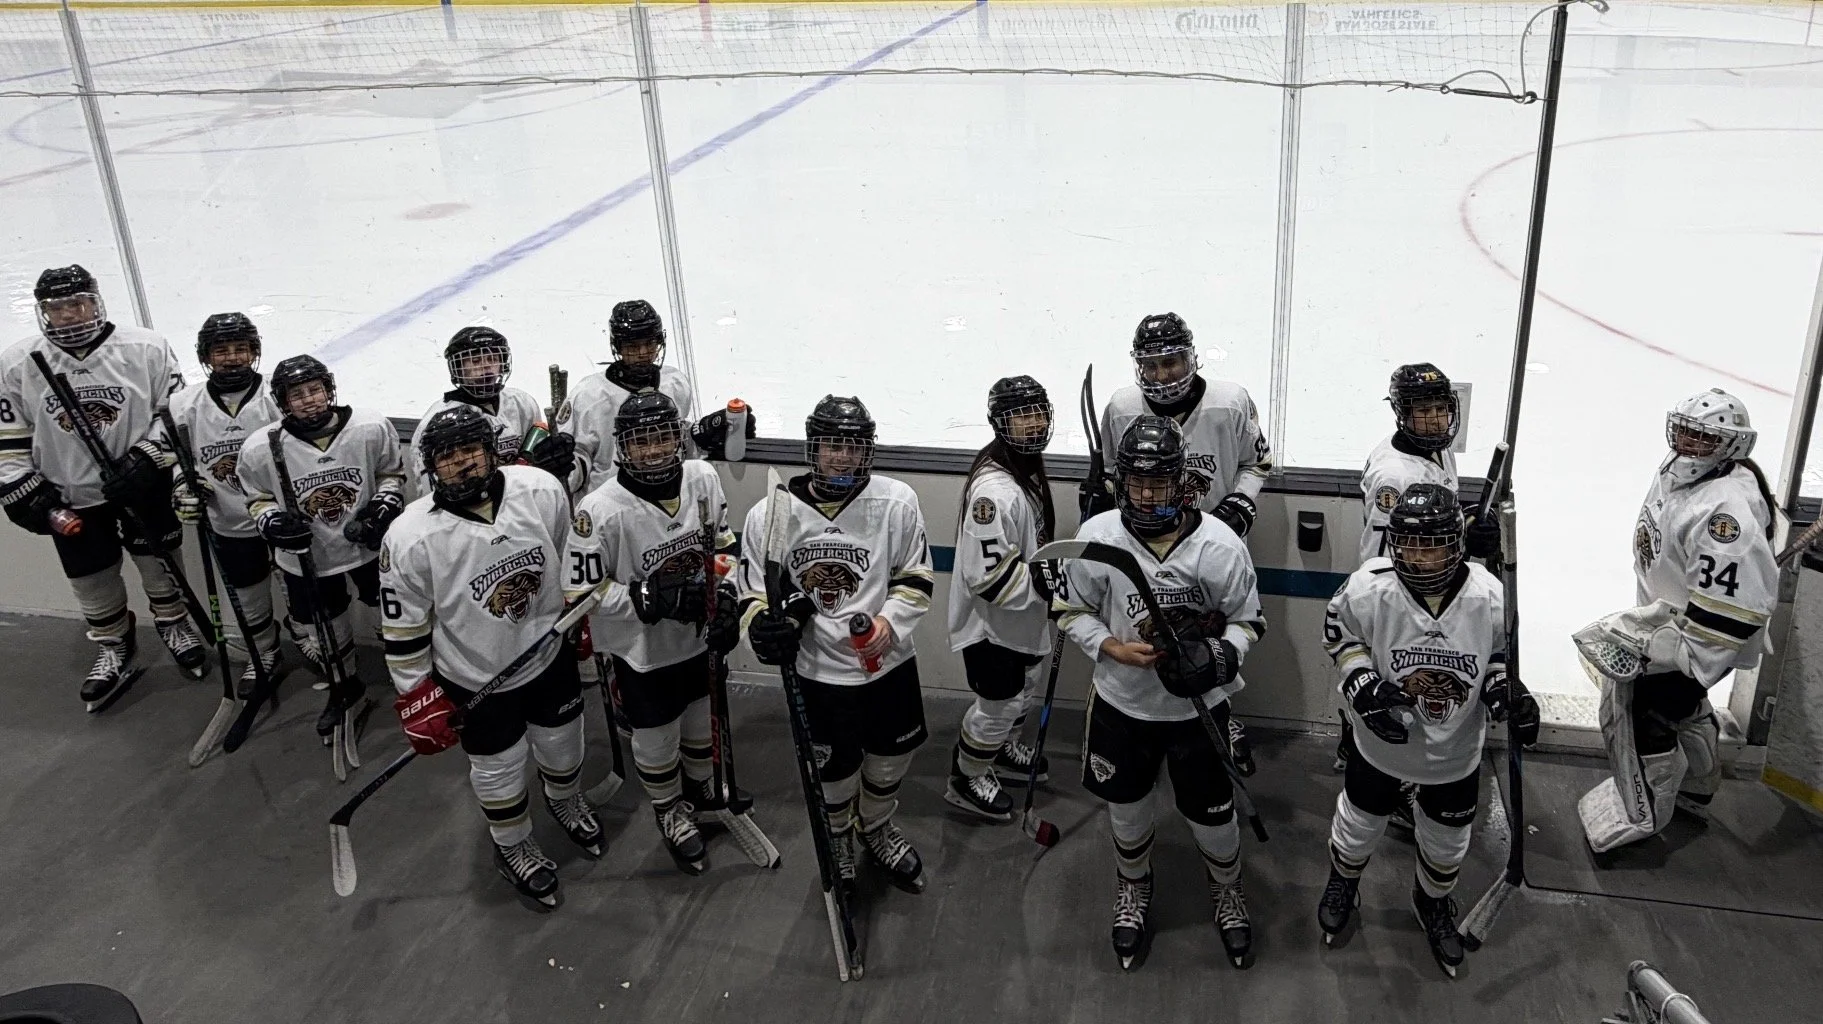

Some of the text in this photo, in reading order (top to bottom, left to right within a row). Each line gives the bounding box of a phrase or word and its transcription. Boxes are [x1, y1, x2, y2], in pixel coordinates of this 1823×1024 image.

[46, 386, 126, 414] SERCATS
[201, 440, 244, 464] SABER
[642, 530, 704, 572] SABERCAT
[790, 546, 871, 573] SABERCATS
[469, 545, 546, 602] SABERCATS
[570, 551, 604, 585] 30
[1698, 554, 1740, 597] 34
[380, 587, 402, 620] 6
[1390, 649, 1480, 680] SABERCATS
[1424, 647, 1460, 656] FRANCISCO
